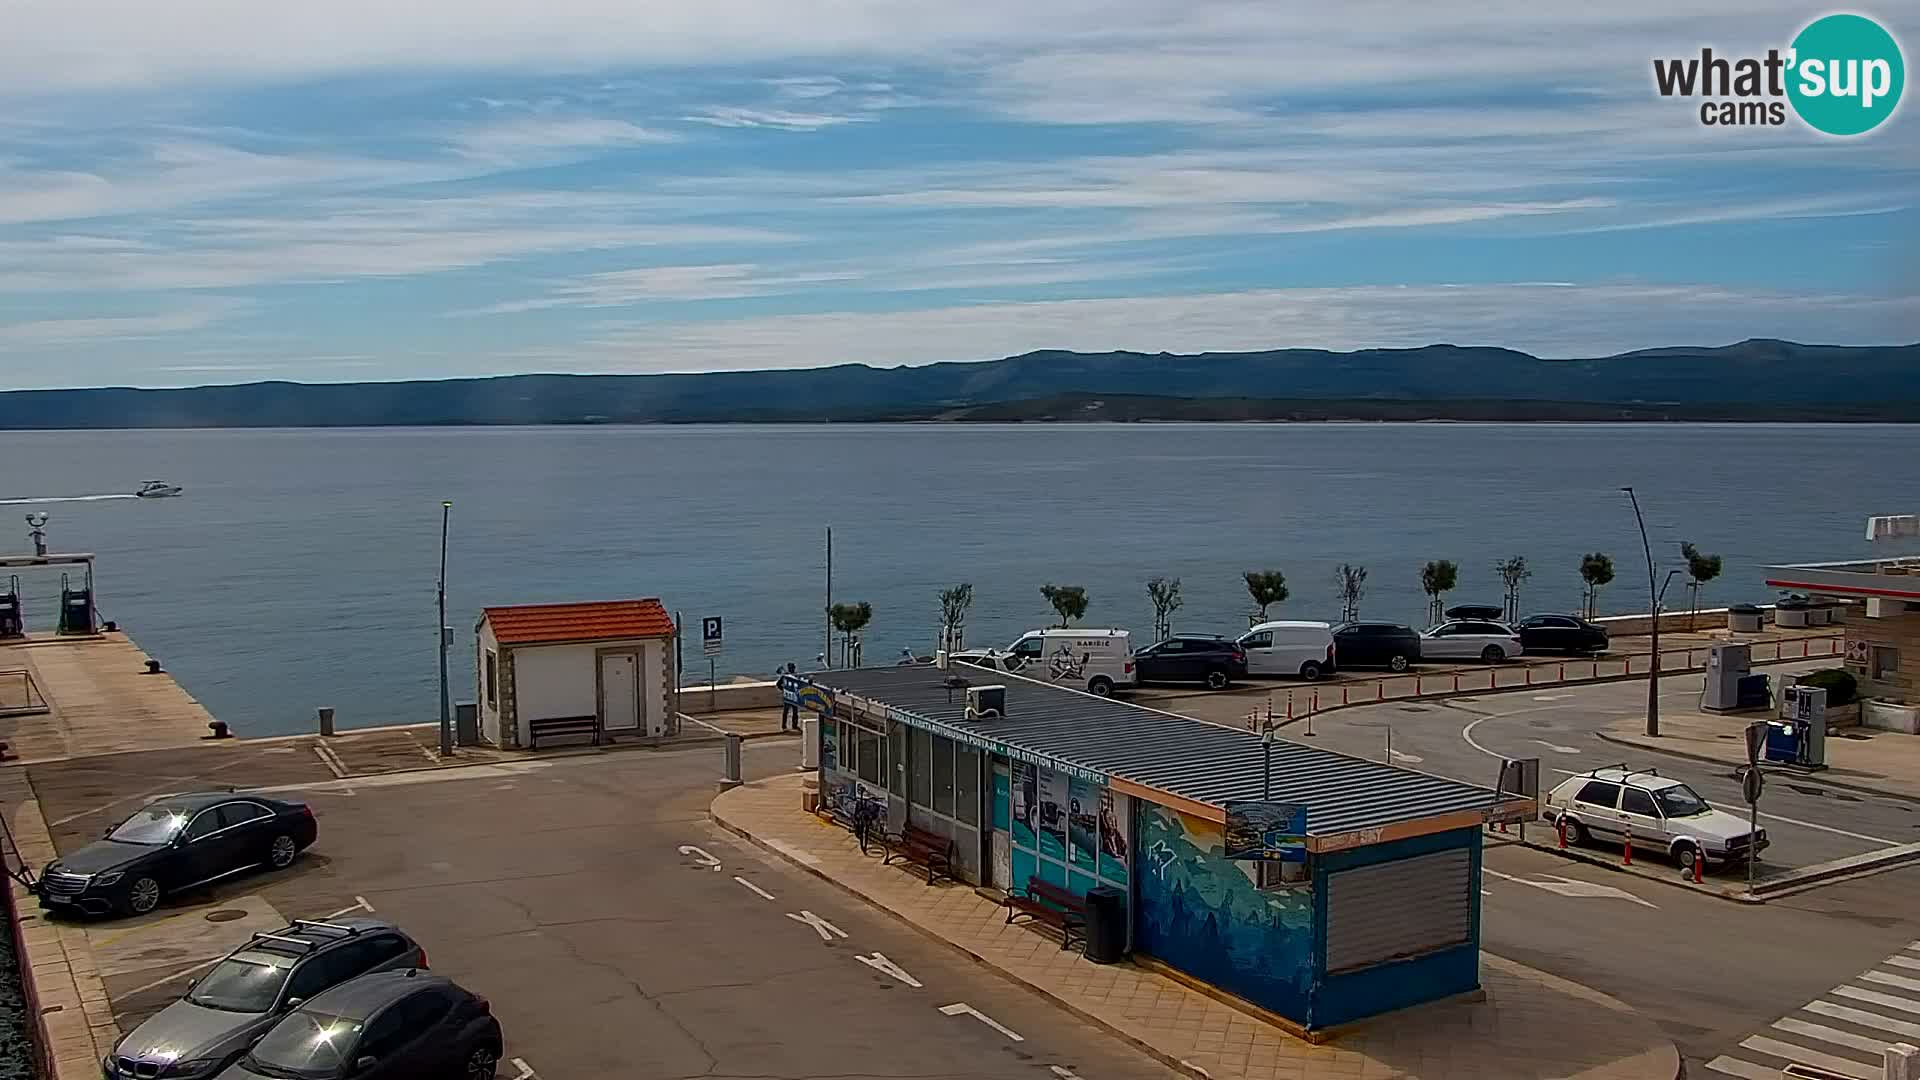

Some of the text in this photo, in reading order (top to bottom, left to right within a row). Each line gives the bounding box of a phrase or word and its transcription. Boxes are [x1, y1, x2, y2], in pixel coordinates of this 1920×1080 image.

[707, 620, 718, 637] P
[969, 735, 997, 752] POSTAJA
[1007, 747, 1020, 759] BUS
[1021, 751, 1051, 768] STATION
[1054, 761, 1077, 776] TICKET
[1080, 769, 1105, 784] OFFICE
